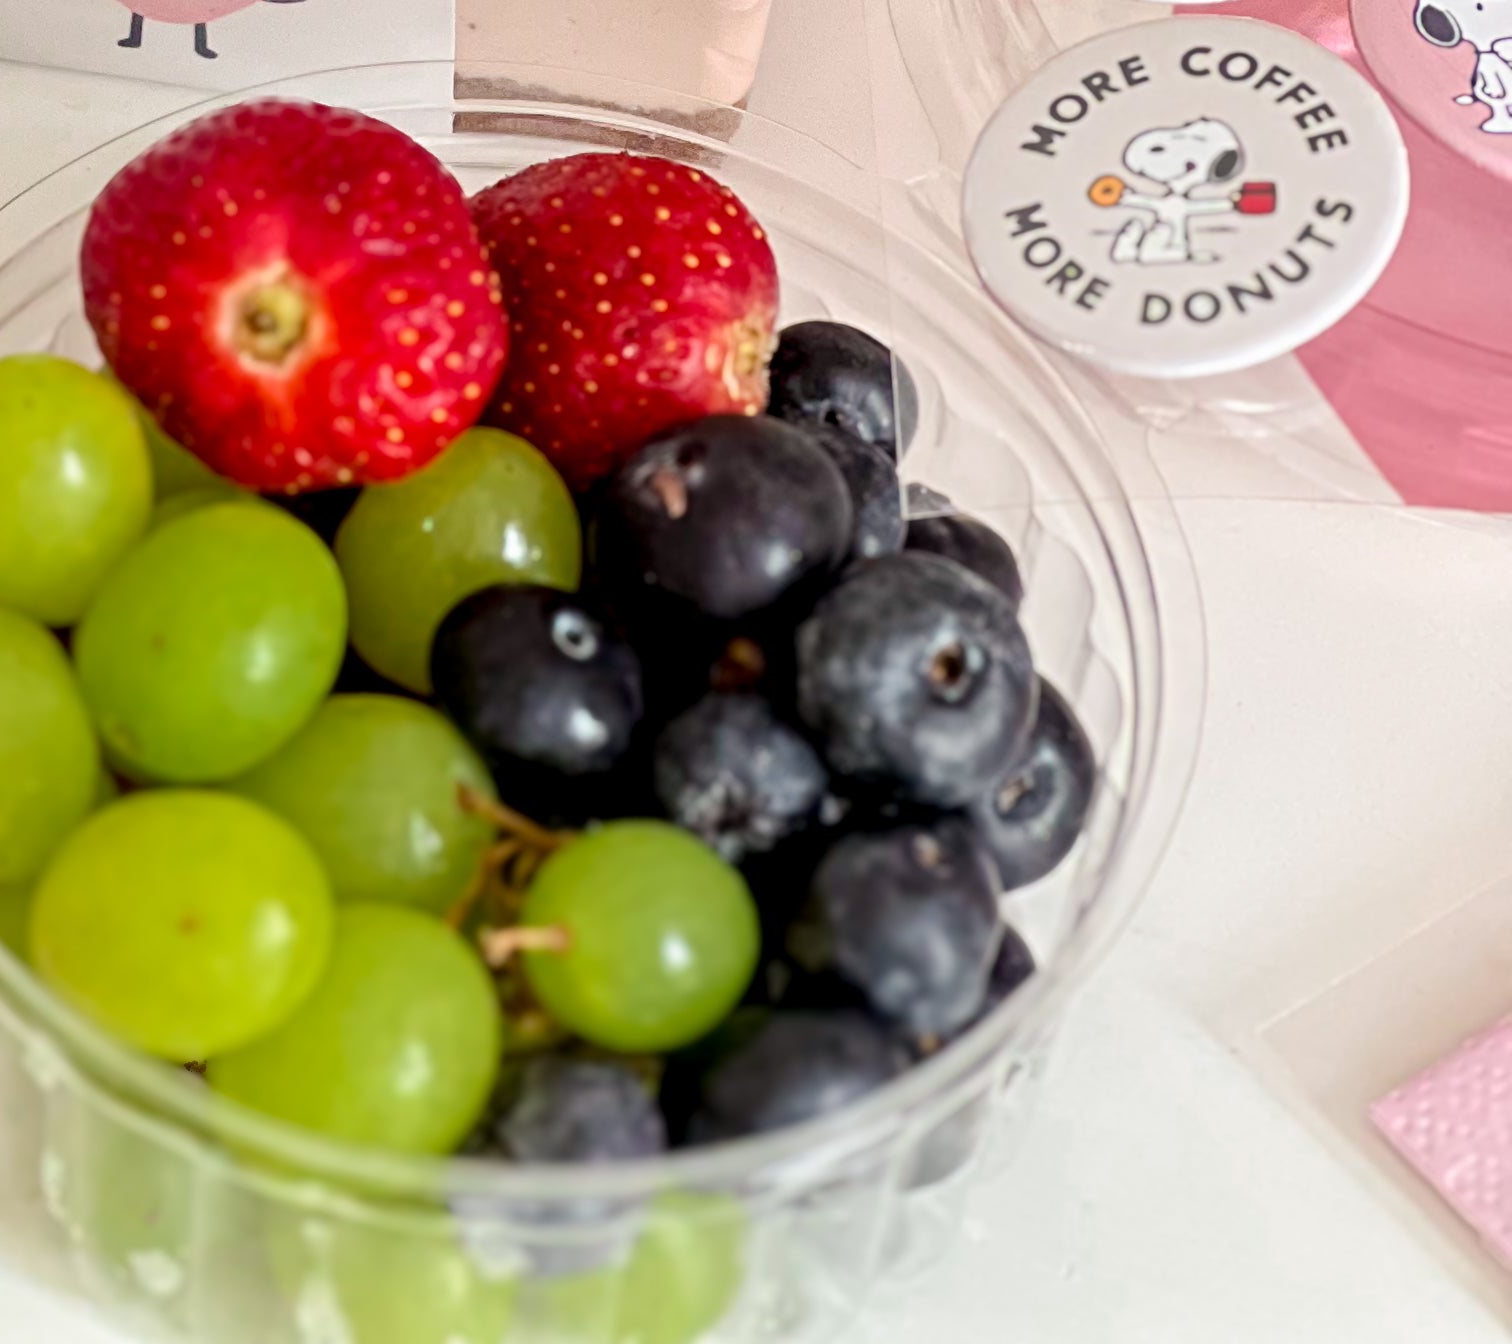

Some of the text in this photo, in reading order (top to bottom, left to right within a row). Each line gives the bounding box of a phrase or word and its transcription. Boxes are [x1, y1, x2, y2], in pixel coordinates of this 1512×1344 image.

[1020, 46, 1349, 158] MORE COFFEE
[1004, 196, 1355, 327] MORE DONUTS
